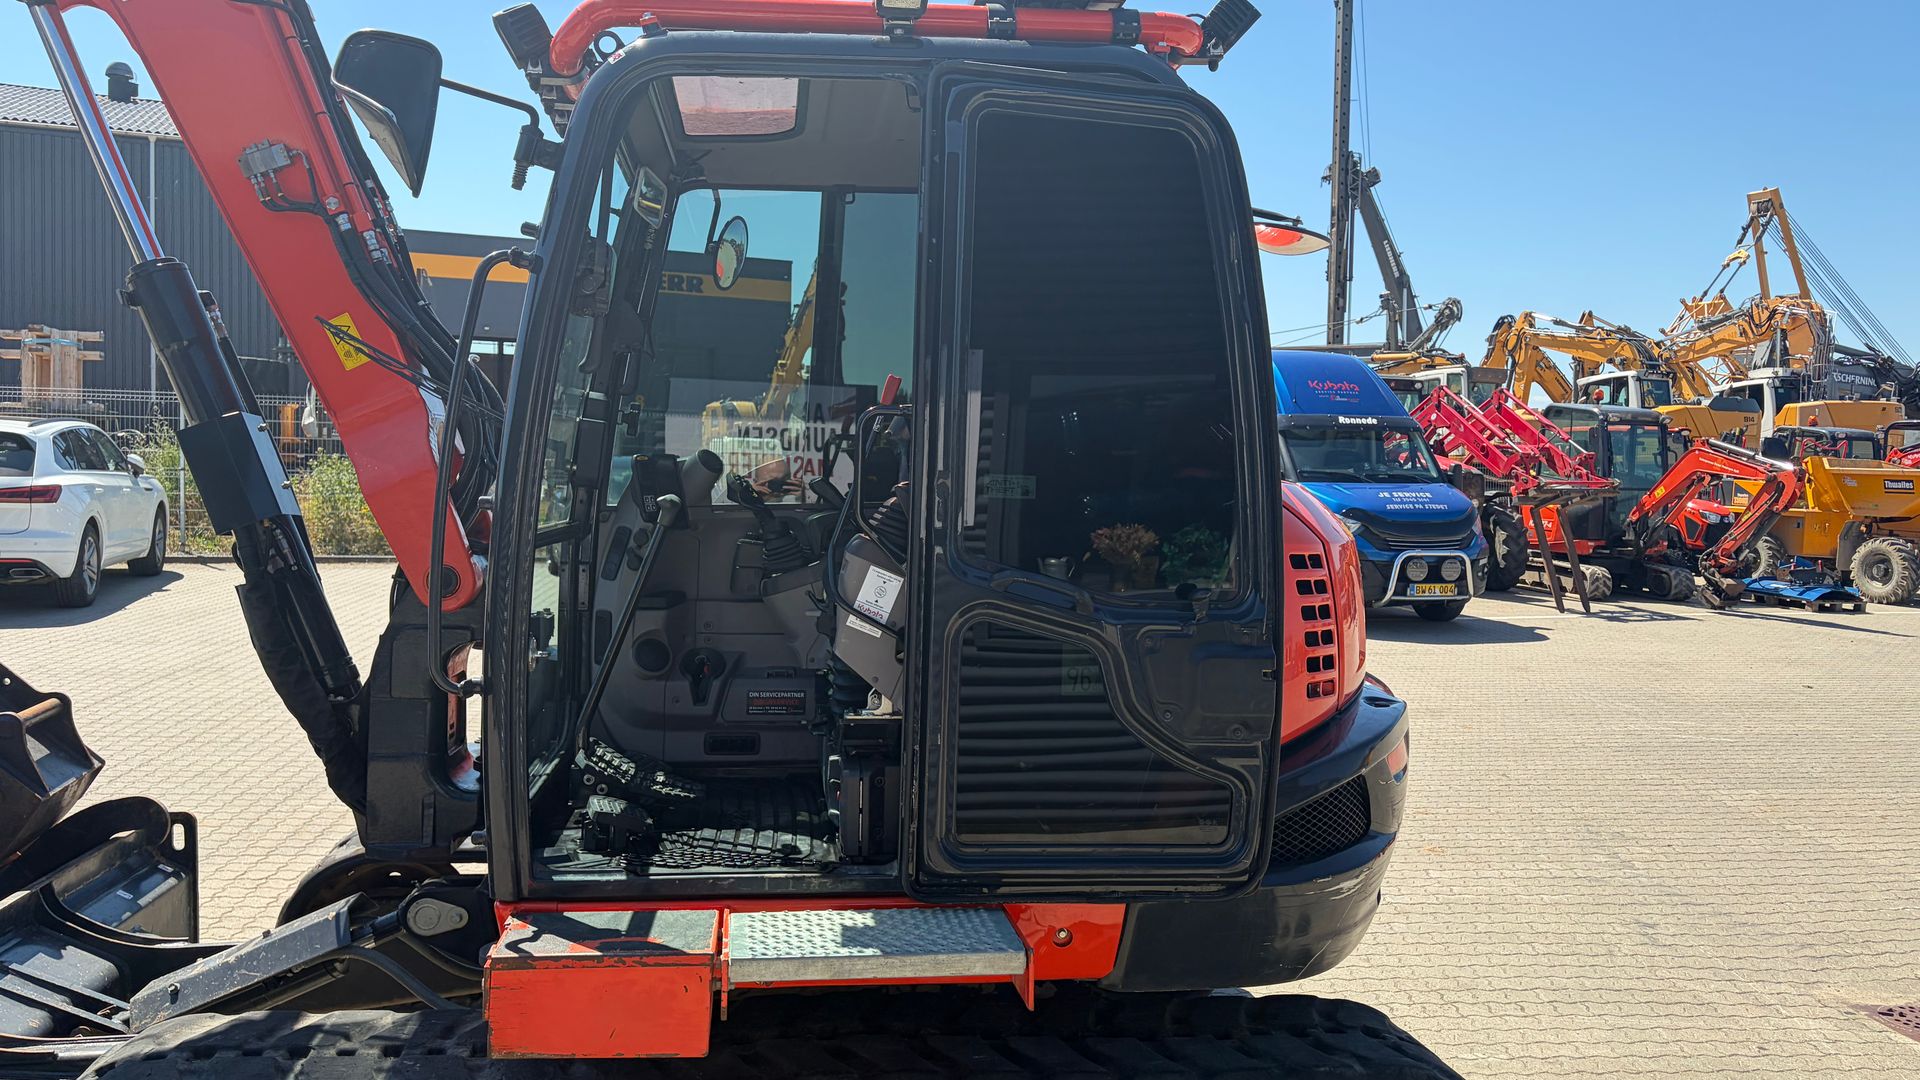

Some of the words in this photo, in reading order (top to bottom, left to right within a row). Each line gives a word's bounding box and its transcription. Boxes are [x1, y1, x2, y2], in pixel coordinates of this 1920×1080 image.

[1308, 380, 1359, 391] Kubota
[1884, 480, 1914, 489] Thwaites
[1416, 585, 1427, 594] BW
[1428, 585, 1437, 594] 61
[857, 603, 884, 620] Kubota
